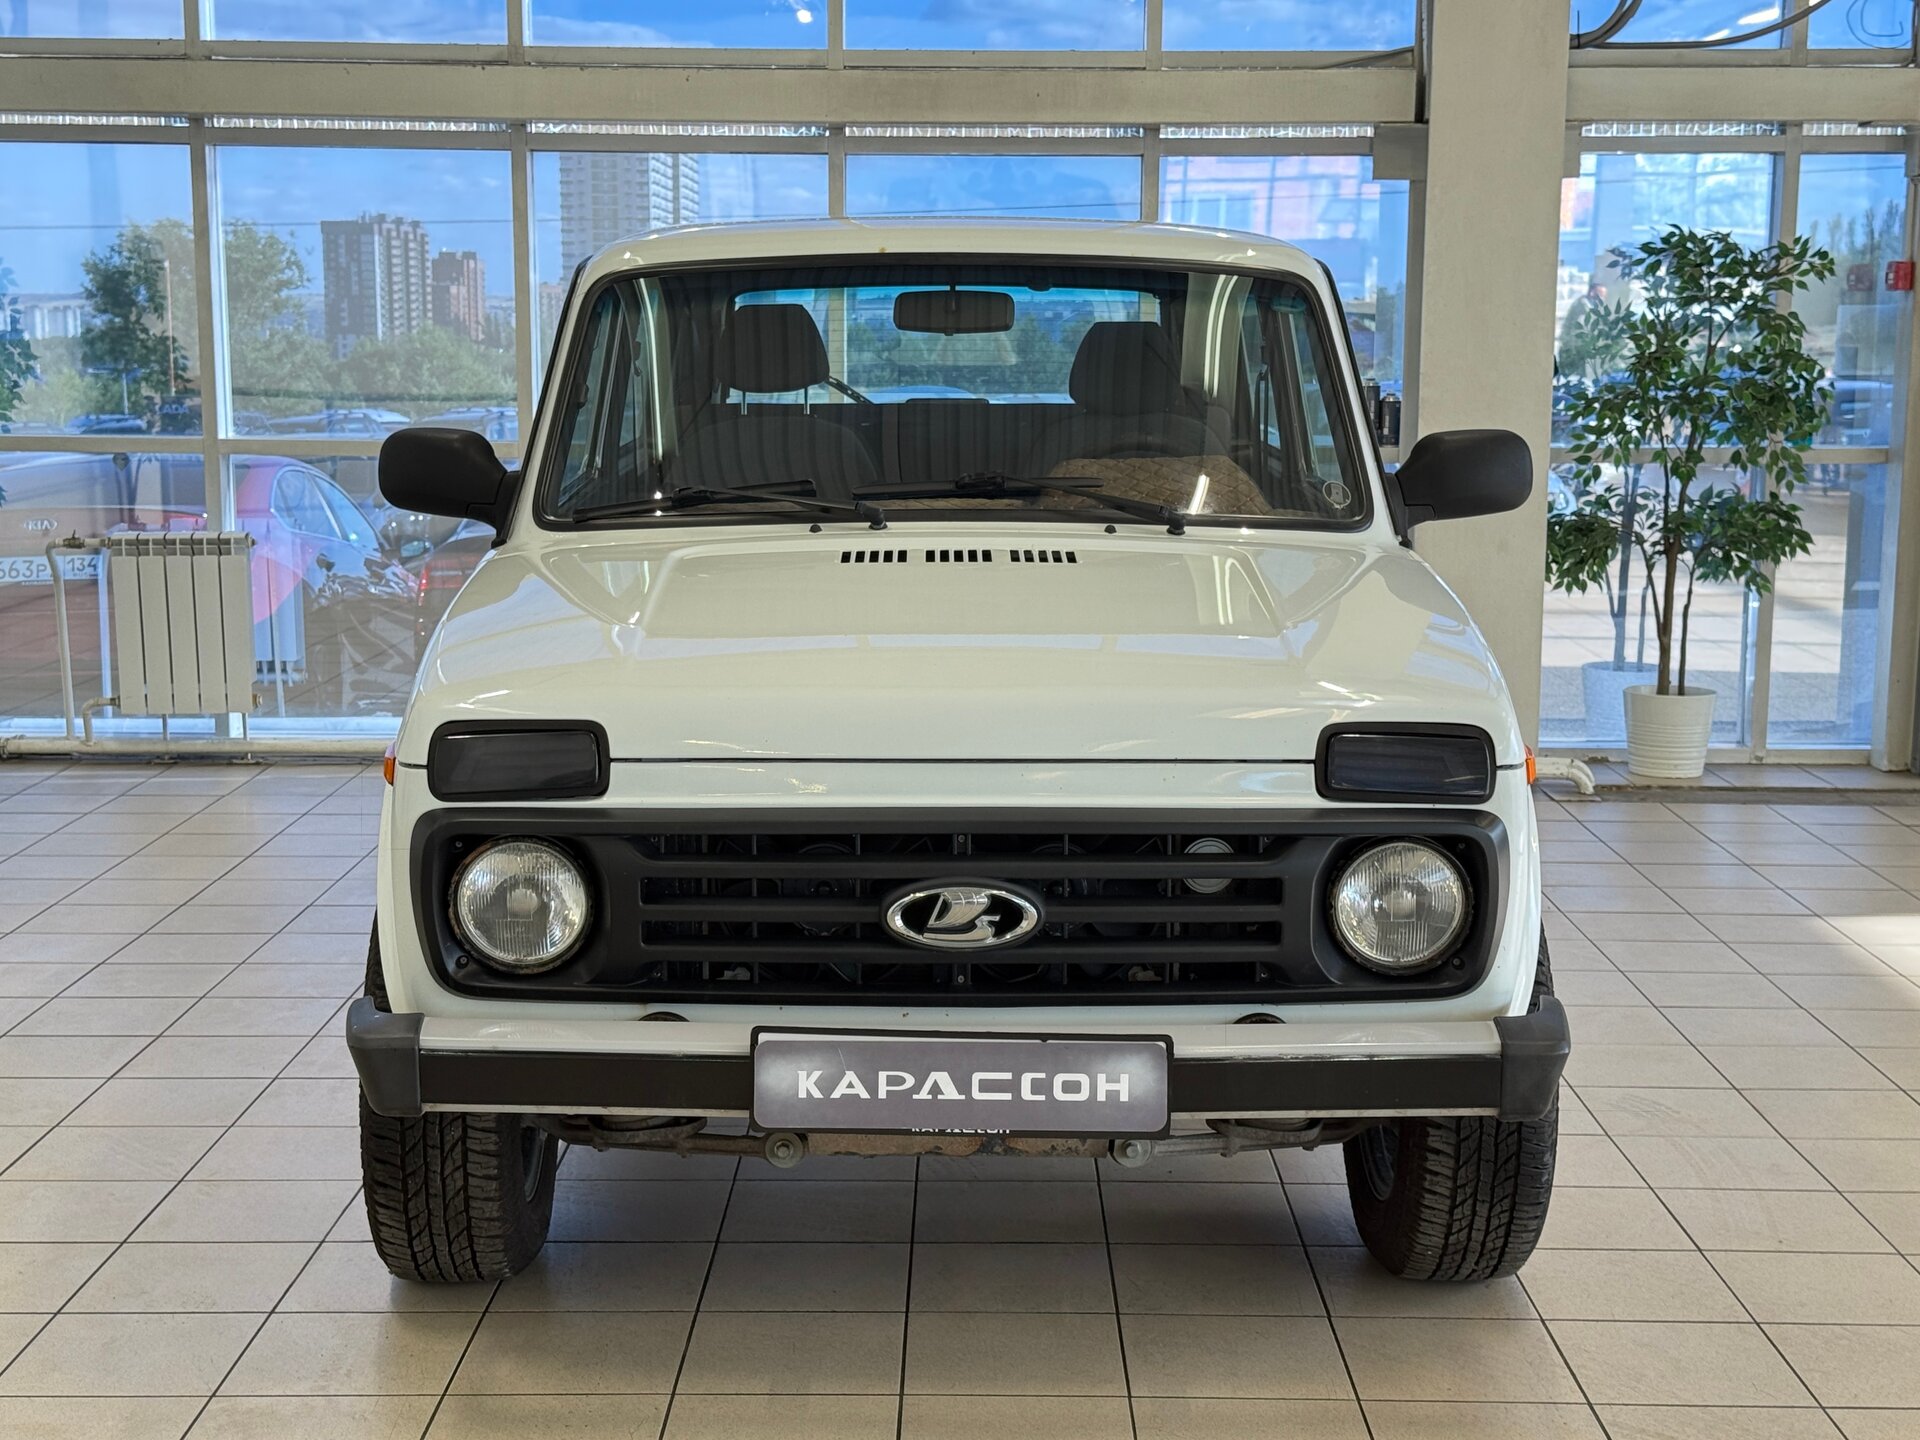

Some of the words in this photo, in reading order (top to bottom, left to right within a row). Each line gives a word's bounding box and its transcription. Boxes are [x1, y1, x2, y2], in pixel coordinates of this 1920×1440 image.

[26, 519, 52, 531] KIA
[67, 557, 97, 572] 134
[797, 1070, 1129, 1102] КАРАССОН
